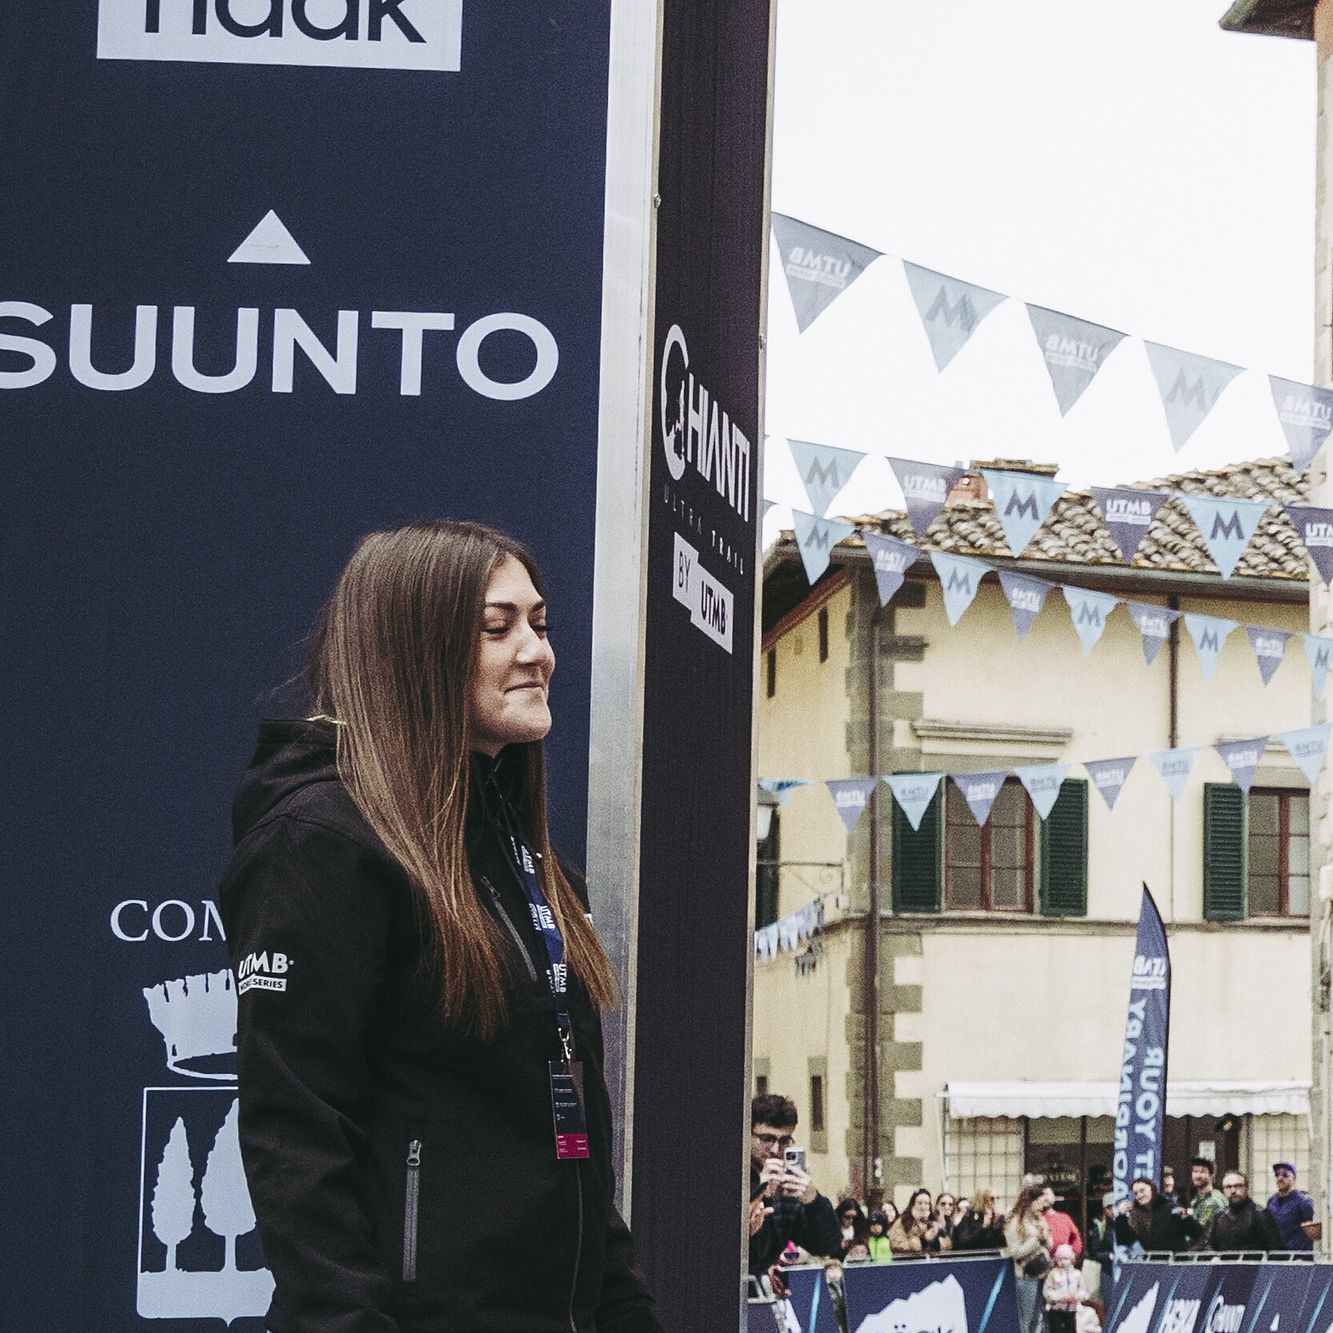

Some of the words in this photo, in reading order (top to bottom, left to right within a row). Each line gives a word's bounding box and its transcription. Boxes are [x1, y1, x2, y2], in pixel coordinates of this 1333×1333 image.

[0, 301, 560, 401] SUUNTO
[664, 484, 702, 535] ULTRA
[712, 530, 743, 575] TRAIL
[1105, 499, 1152, 516] UTMB
[678, 550, 691, 592] BY
[701, 581, 727, 635] UTMB
[111, 898, 227, 943] COM
[238, 950, 289, 980] UTMB
[252, 978, 284, 990] SERIES
